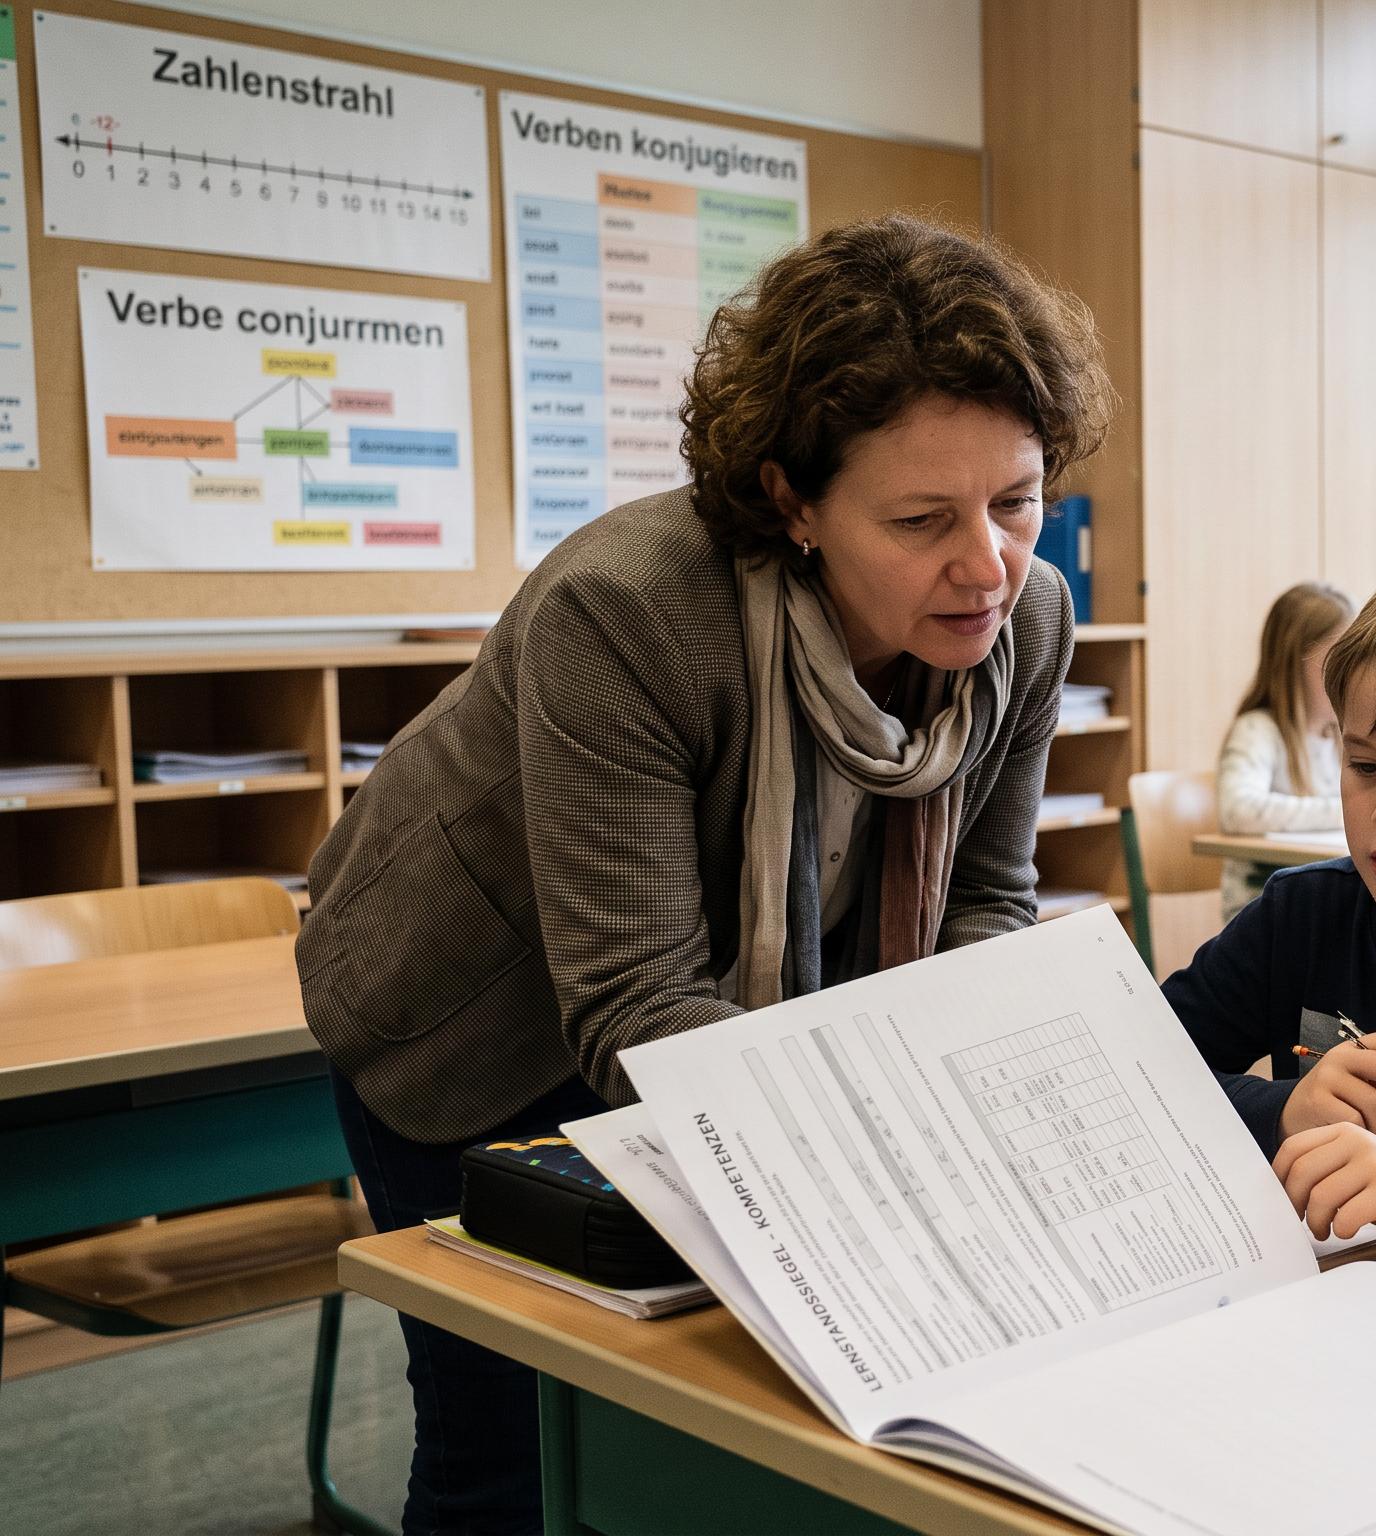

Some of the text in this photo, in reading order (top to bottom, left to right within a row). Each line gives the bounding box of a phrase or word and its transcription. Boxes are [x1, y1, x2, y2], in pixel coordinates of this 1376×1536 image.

[153, 48, 394, 117] Zahlenstrahl
[512, 110, 798, 182] Verben konjugieren
[73, 160, 85, 179] 0
[107, 164, 115, 181] 1
[138, 167, 149, 187] 2
[168, 171, 181, 190] 3
[200, 176, 210, 194] 4
[288, 185, 299, 204] 7
[107, 289, 445, 348] Verbe conjurrmen
[693, 1112, 770, 1230] KOMPETENZEN
[772, 1243, 883, 1393] LERNSTANDSSIEGEL
